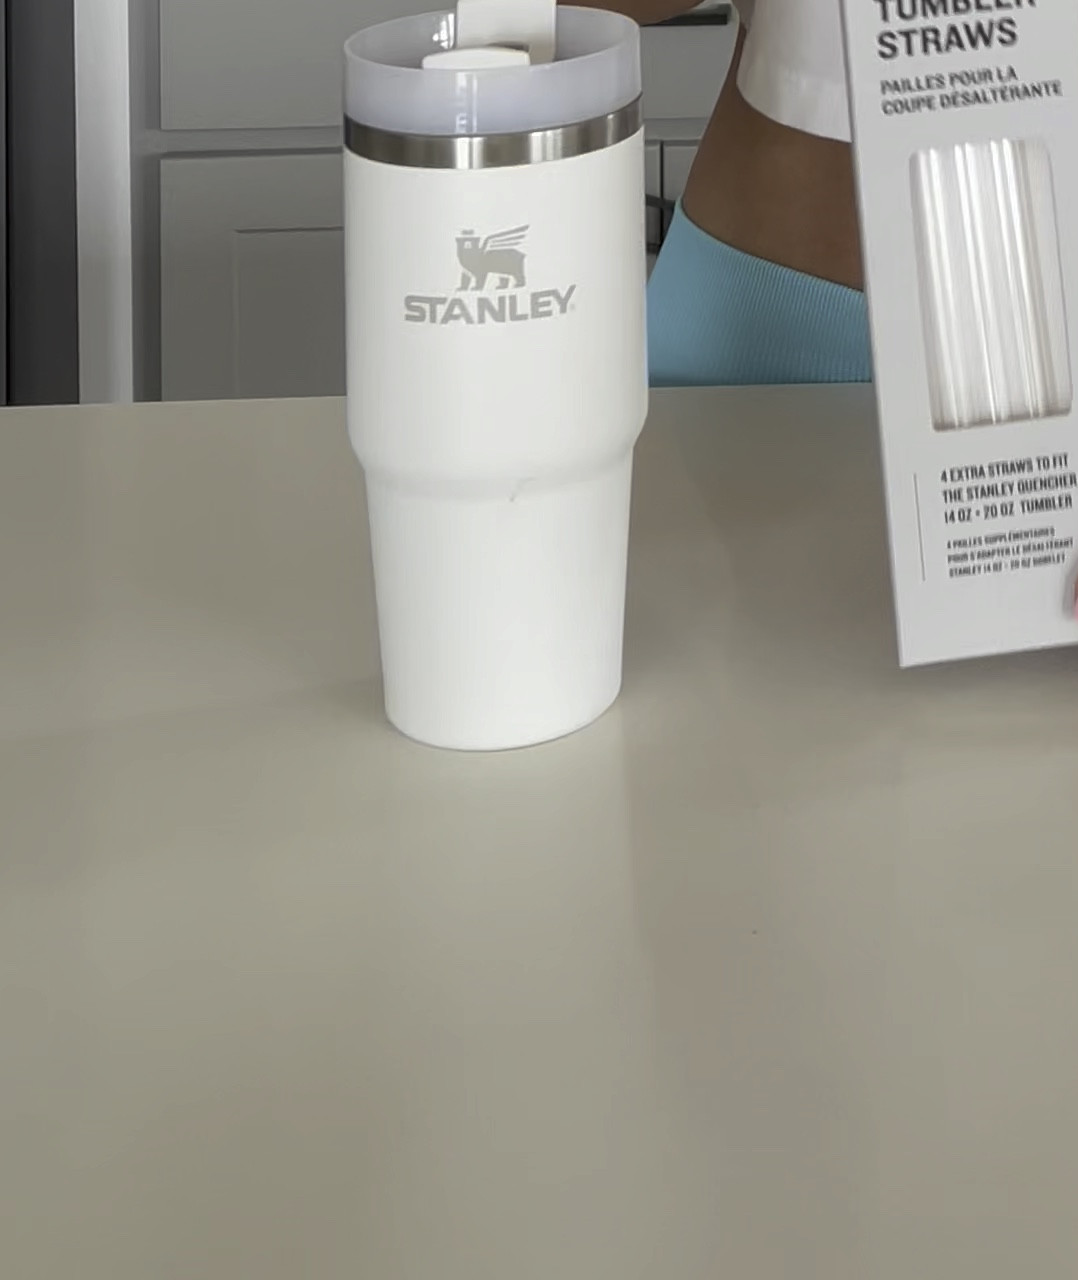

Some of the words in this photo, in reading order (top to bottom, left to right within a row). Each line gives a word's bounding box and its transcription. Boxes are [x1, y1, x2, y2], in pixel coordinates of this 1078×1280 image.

[877, 17, 1018, 60] STRAWS
[880, 72, 946, 95] PAILLES
[948, 67, 994, 88] POUR
[996, 64, 1019, 83] LA
[881, 95, 936, 116] COUPE
[404, 284, 576, 324] STANLEY
[941, 467, 948, 482] 4
[950, 463, 986, 482] EXTRA
[988, 456, 1033, 478] STRAWS
[1035, 455, 1050, 471] TO
[1052, 452, 1068, 469] FIT
[943, 487, 963, 504] THE
[966, 481, 1014, 501] STANLEY
[1017, 471, 1078, 494] QUENCHER
[944, 508, 955, 524] 14
[957, 507, 971, 522] OZ
[983, 503, 997, 520] 20
[1000, 501, 1014, 517] OZ
[1020, 493, 1072, 514] TUMBLER
